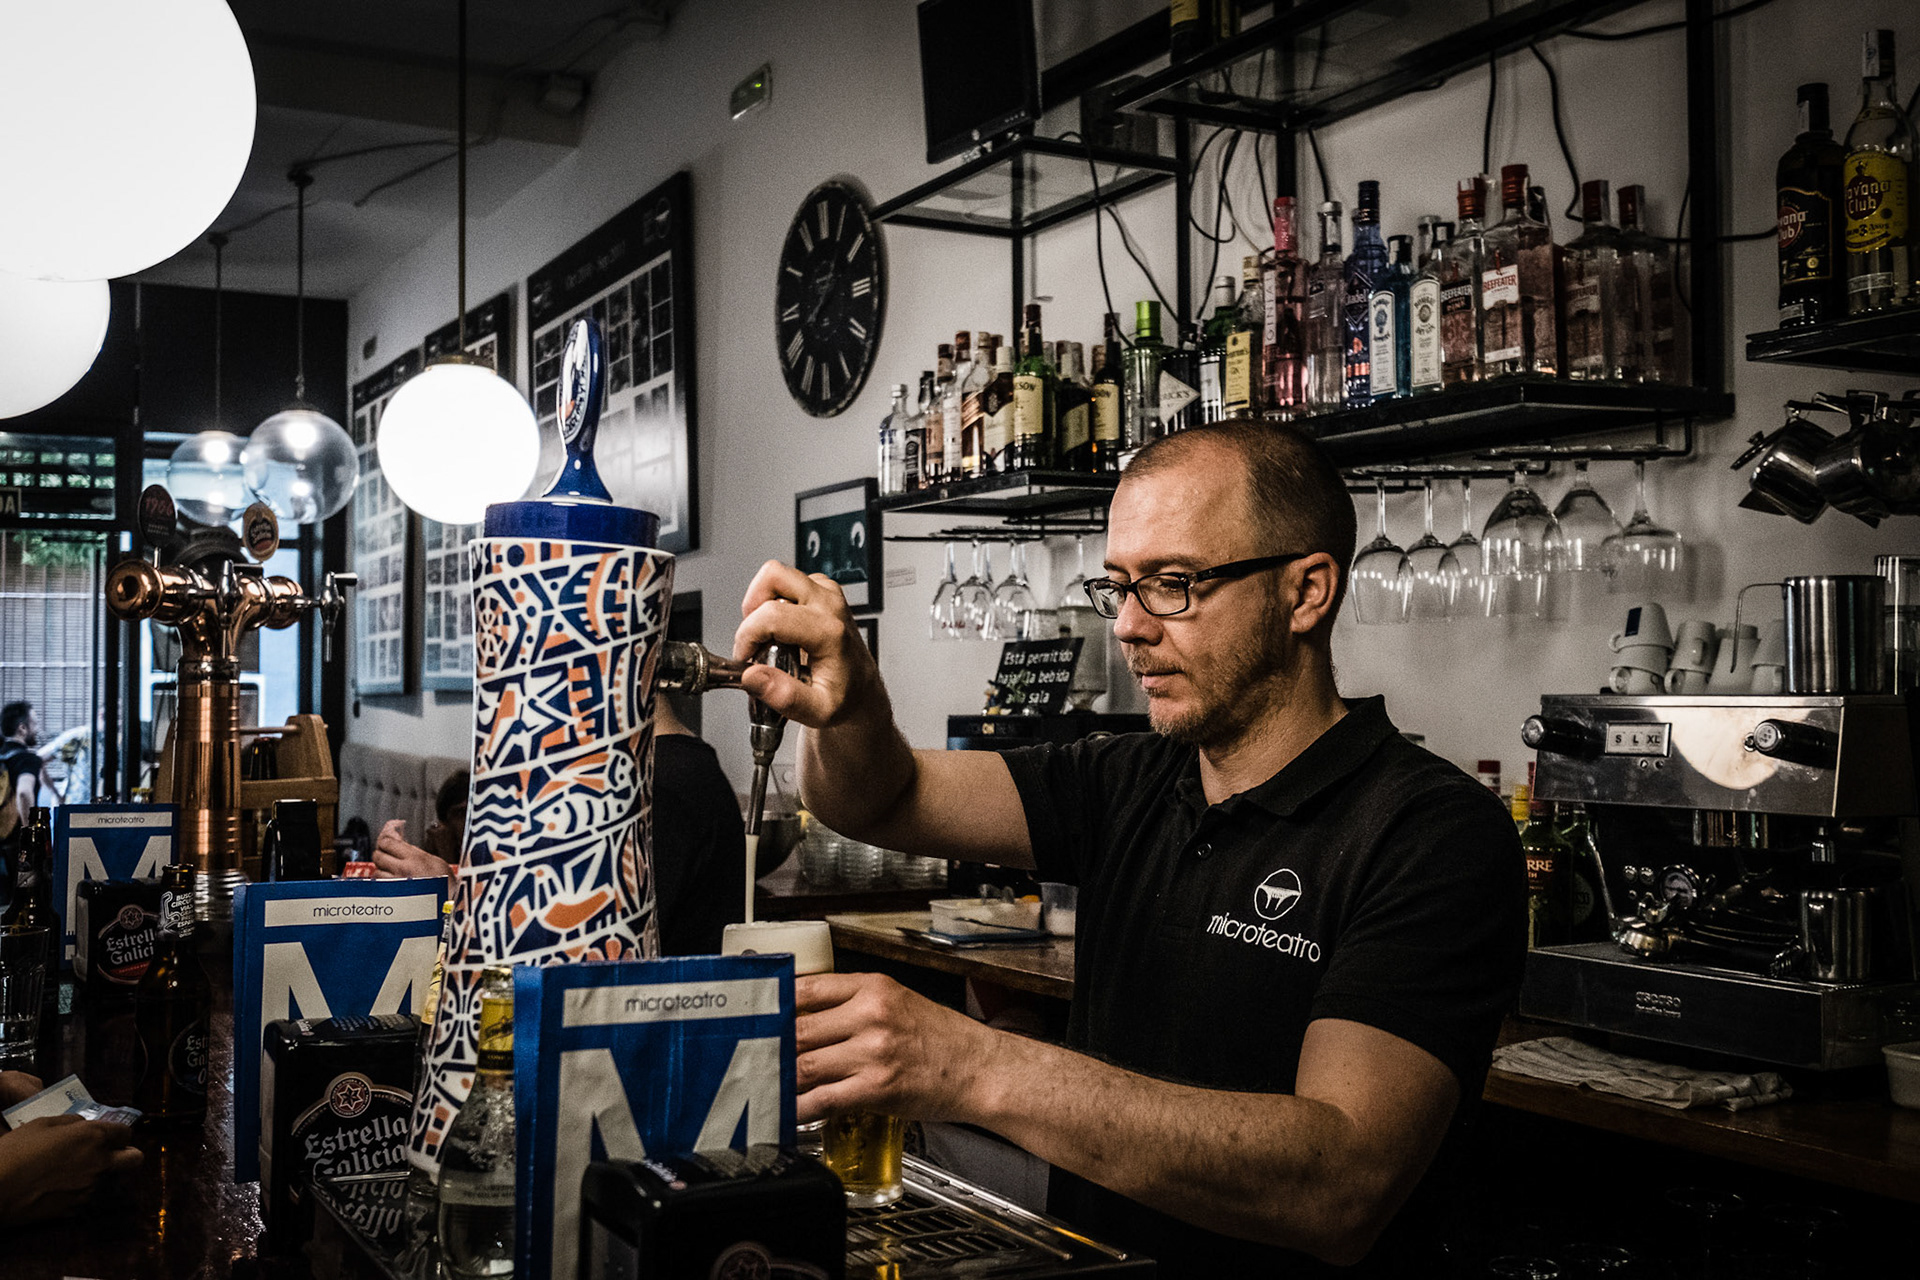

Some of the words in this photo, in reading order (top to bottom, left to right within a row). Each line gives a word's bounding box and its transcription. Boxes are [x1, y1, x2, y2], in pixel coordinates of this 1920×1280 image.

[1615, 734, 1622, 744] S
[1632, 734, 1639, 744] L
[1647, 734, 1661, 744] XL
[97, 815, 146, 825] microteatro
[313, 902, 394, 918] microteatro
[106, 928, 156, 952] Estrell
[1206, 911, 1321, 963] microteatro
[110, 942, 155, 965] Galici
[624, 991, 728, 1014] microteatro
[304, 1114, 410, 1161] Estrella
